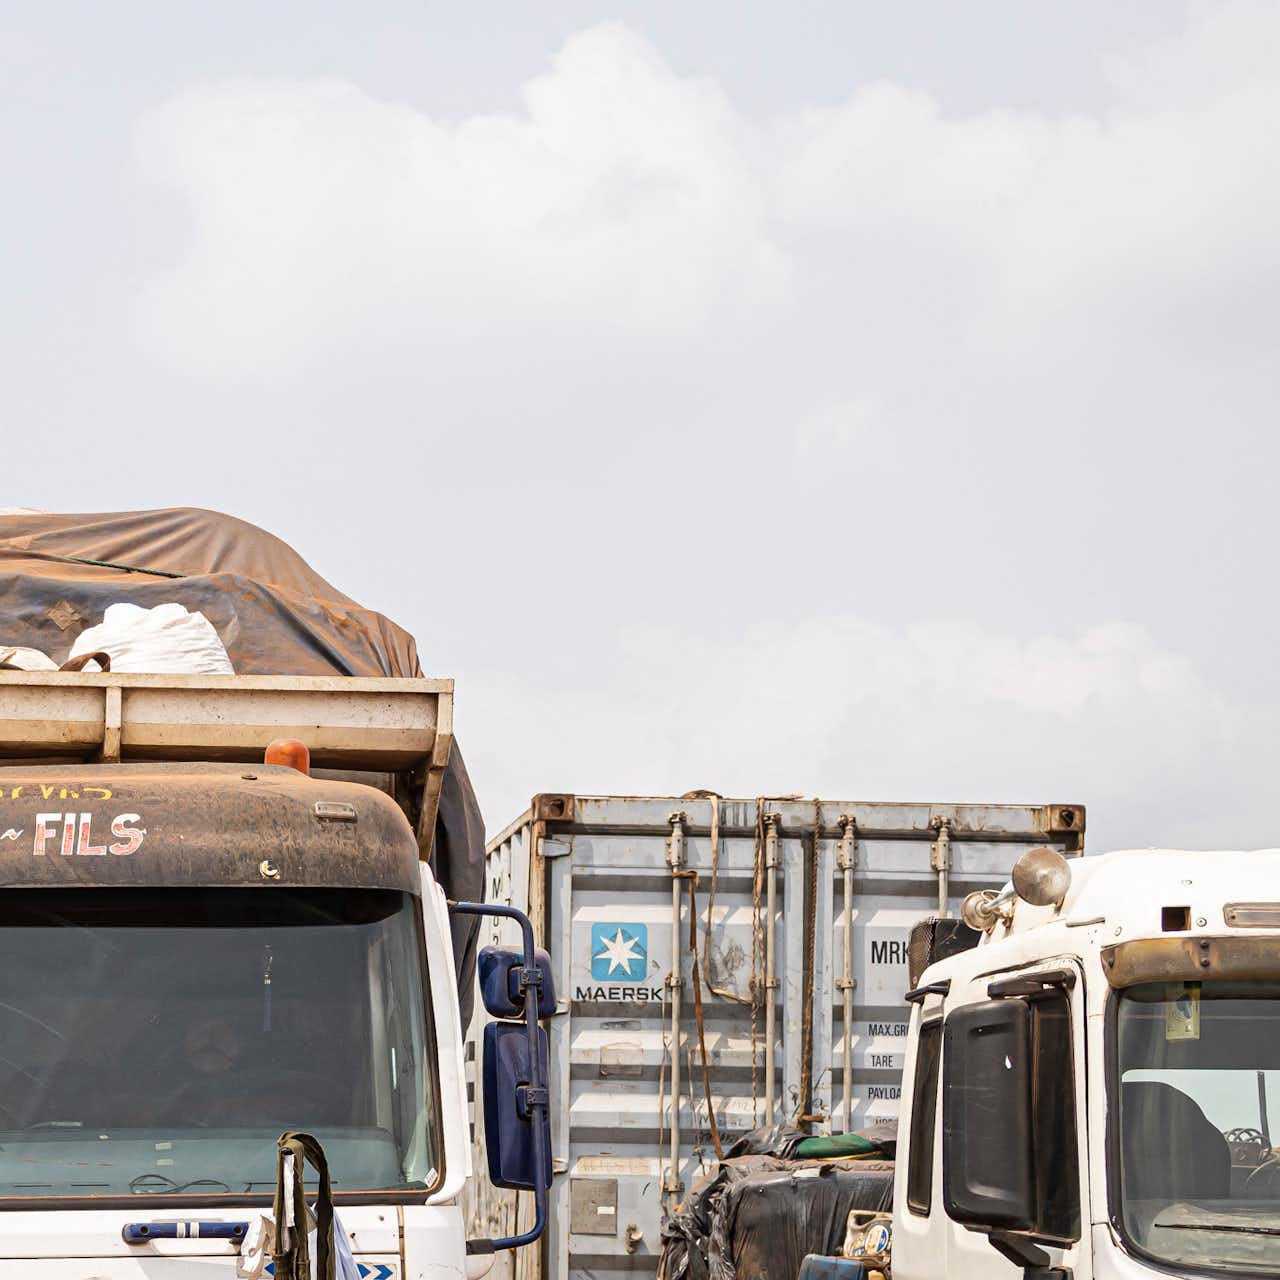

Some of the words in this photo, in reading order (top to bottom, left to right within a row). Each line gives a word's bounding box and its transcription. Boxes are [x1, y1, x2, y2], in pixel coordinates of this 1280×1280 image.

[33, 811, 147, 857] FILS
[575, 986, 663, 1001] MAERSK
[871, 1055, 893, 1068] TARE
